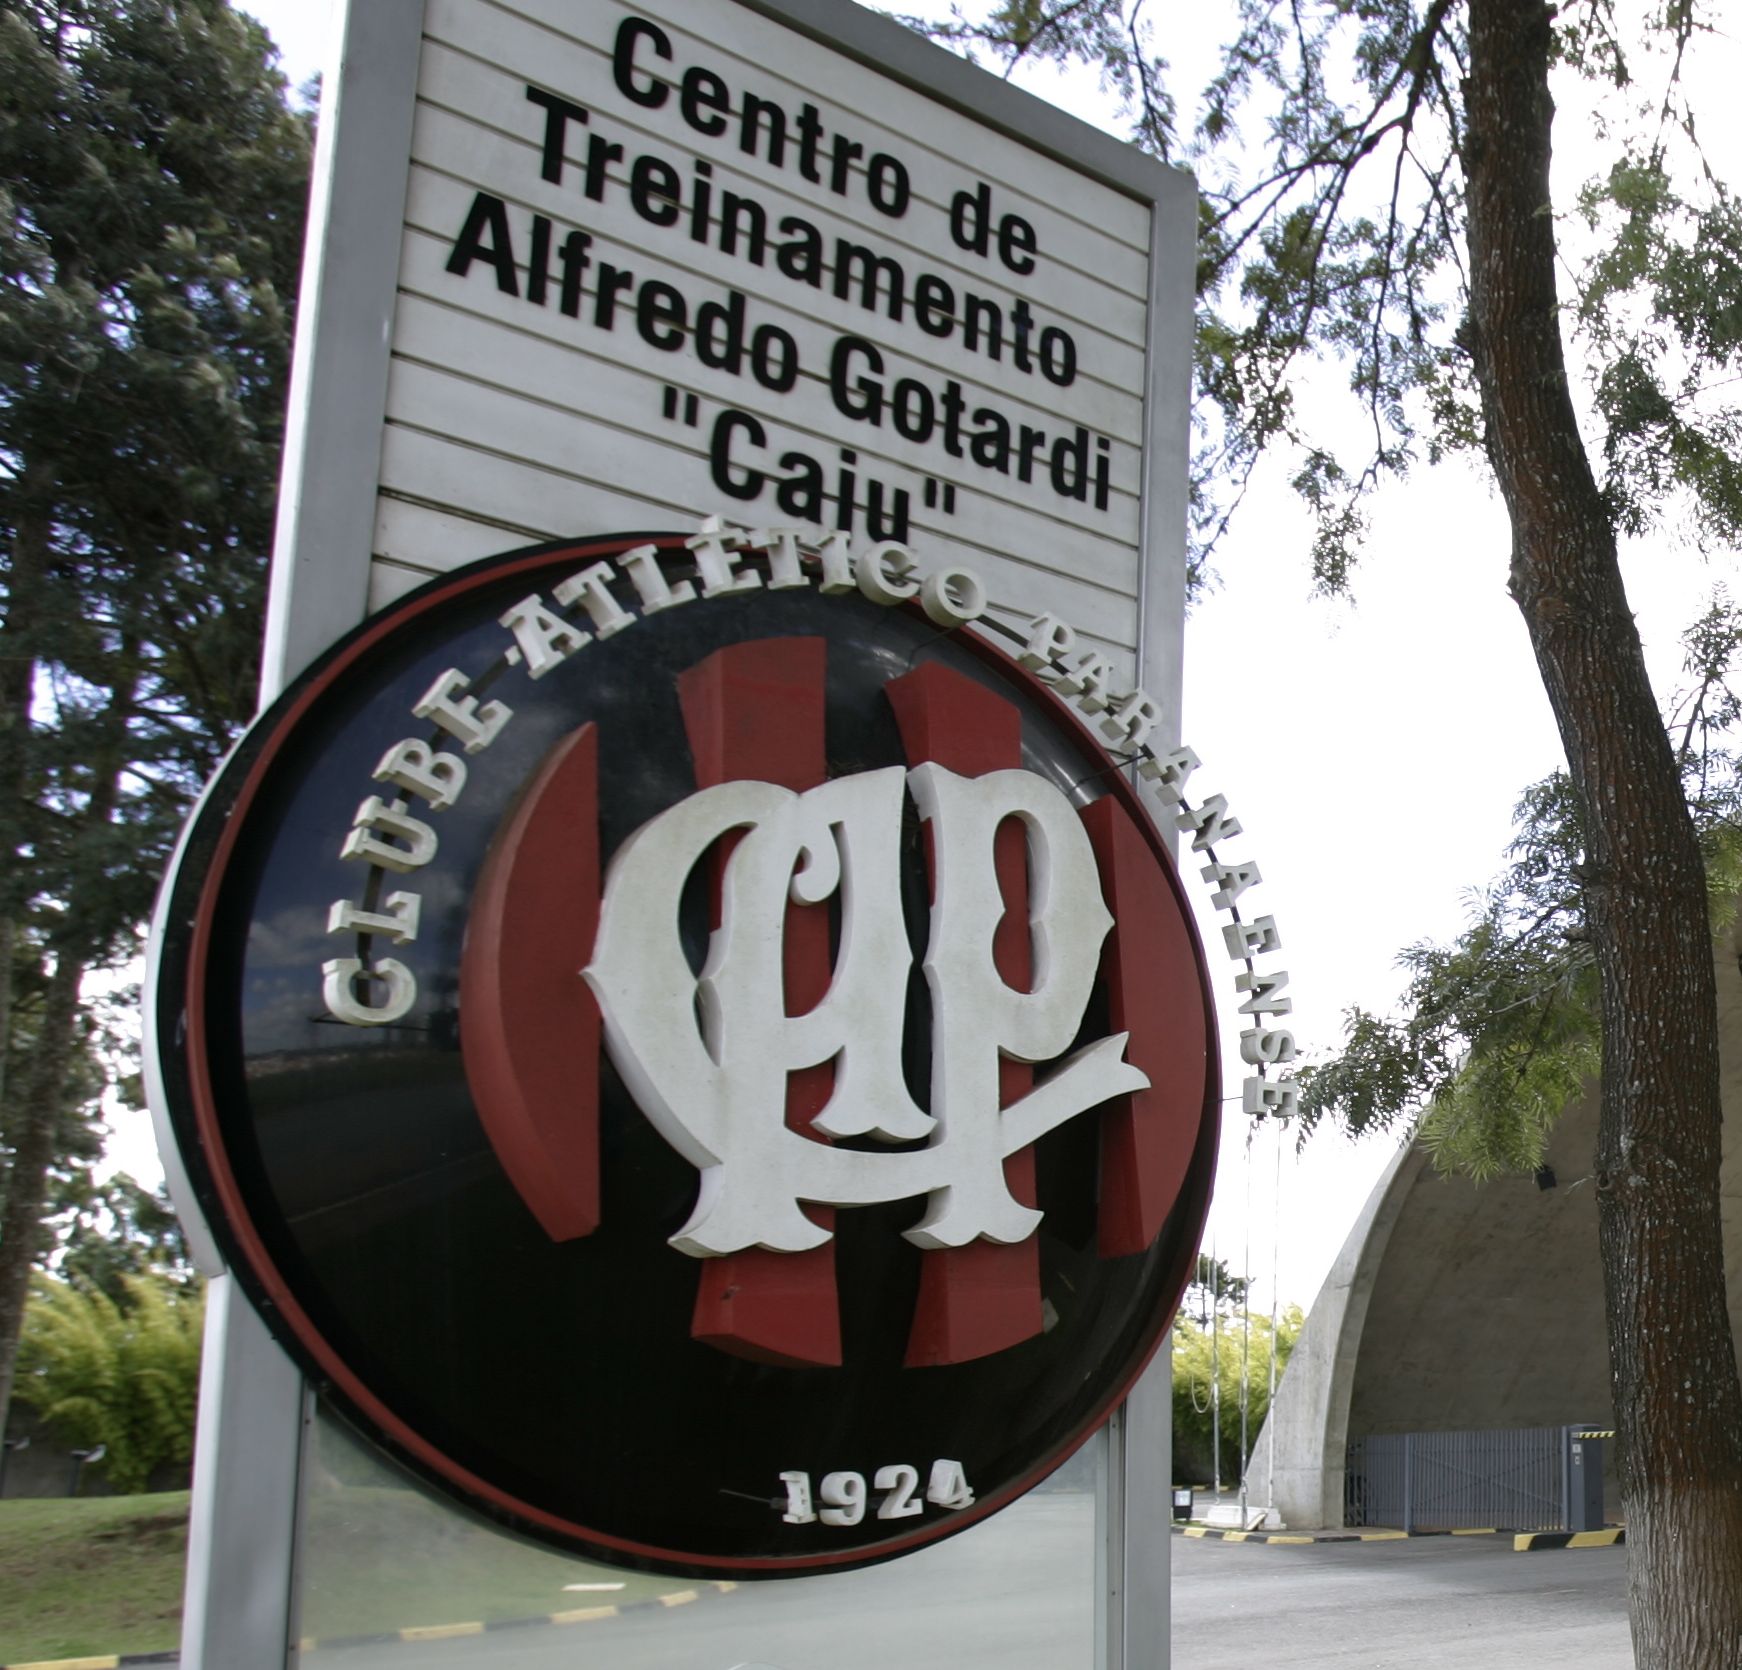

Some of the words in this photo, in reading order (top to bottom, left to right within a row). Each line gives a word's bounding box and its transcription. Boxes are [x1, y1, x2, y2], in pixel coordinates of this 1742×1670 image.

[525, 85, 1077, 388] Treinamento
[613, 15, 910, 219] Centro
[949, 182, 1037, 277] de
[444, 191, 799, 395] Alfredo
[829, 334, 1110, 512] Gotardi
[322, 668, 514, 1026] CLUBE
[498, 514, 987, 680] ATLÉTICO
[1018, 611, 1299, 1118] PARANAENSE
[779, 1459, 976, 1527] 1924
